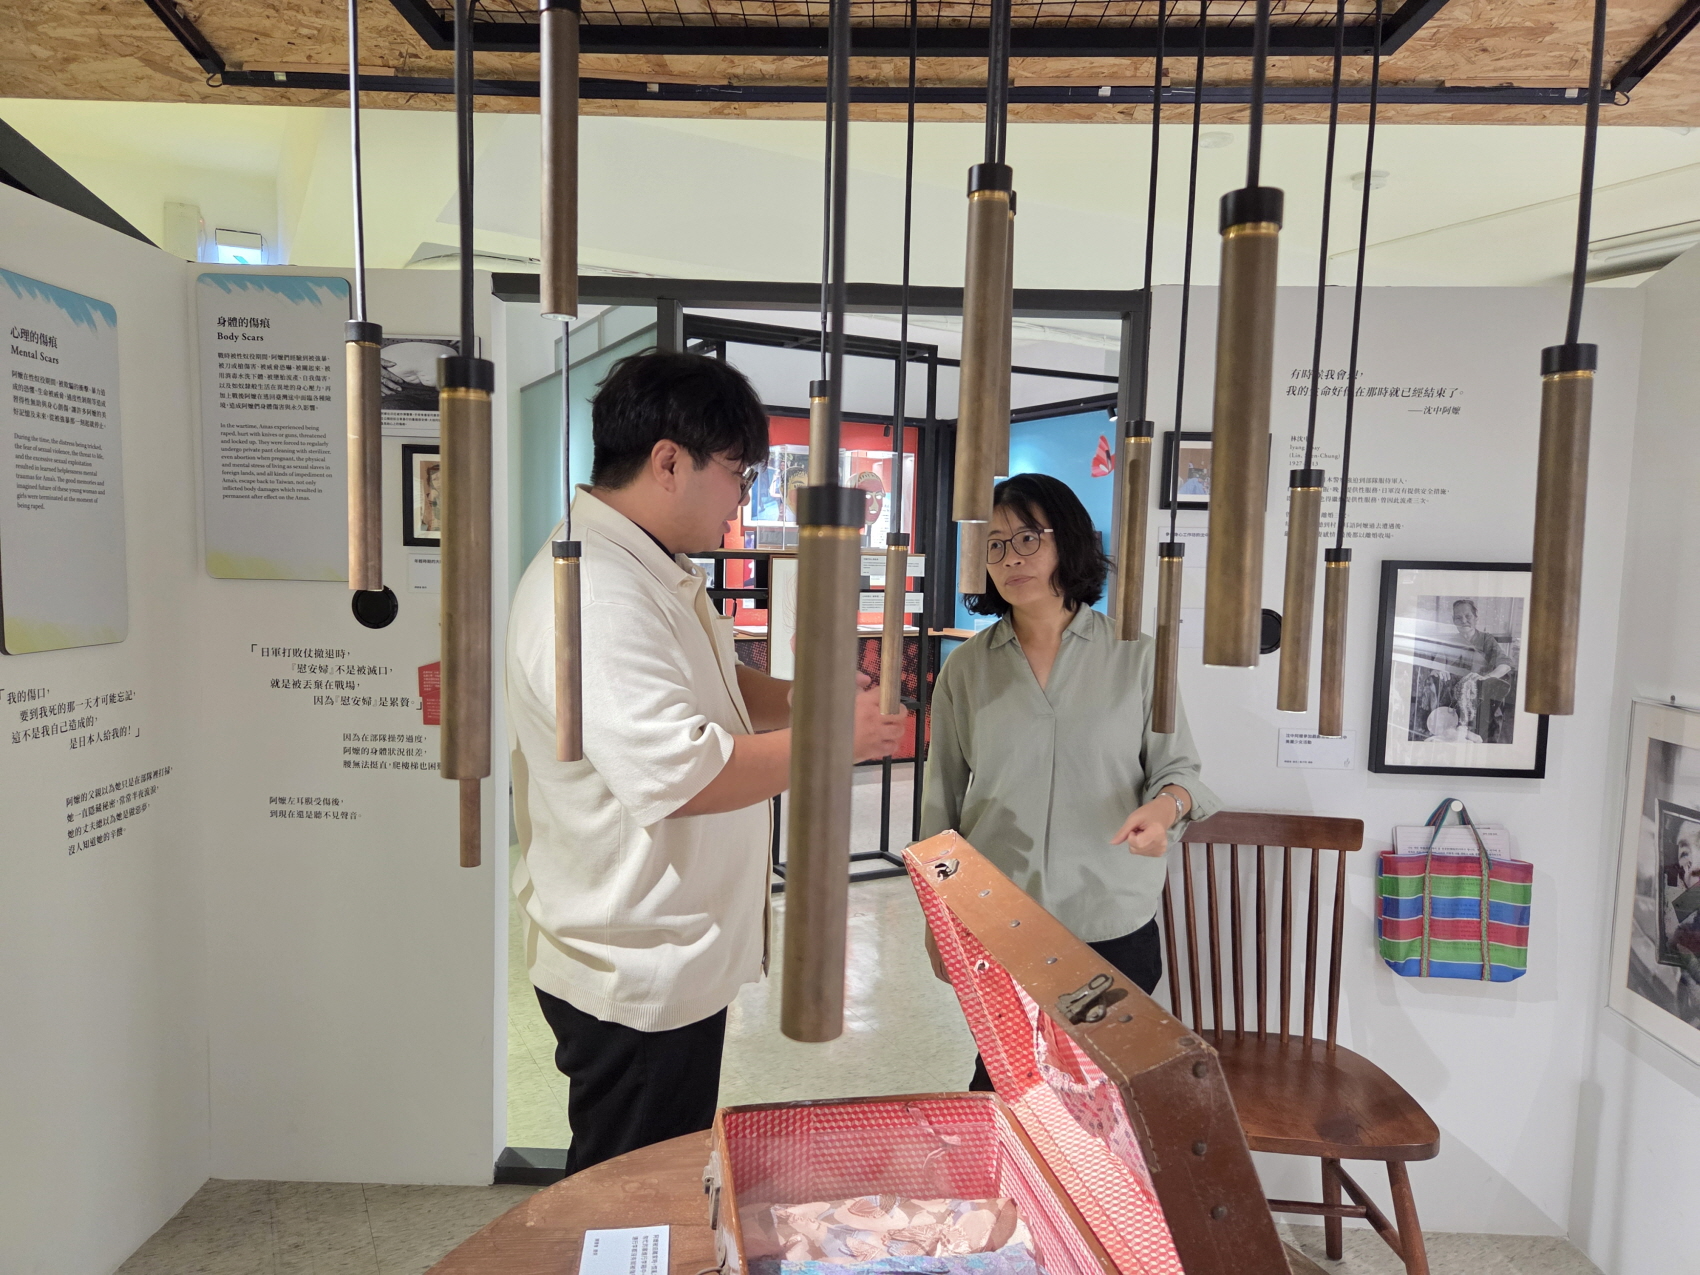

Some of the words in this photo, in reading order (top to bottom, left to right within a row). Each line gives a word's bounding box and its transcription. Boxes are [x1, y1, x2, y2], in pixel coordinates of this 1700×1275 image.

[217, 316, 270, 329] 身體的傷痕
[10, 326, 58, 349] 心理的傷痕
[217, 332, 239, 342] Body
[242, 333, 264, 341] Scars
[11, 345, 38, 360] Mental
[40, 352, 59, 364] Scars
[1286, 385, 1465, 399] 我的命好在那時就已經結束了。
[251, 644, 351, 659] 「日軍打敗仗撤退時，
[270, 678, 360, 691] 就是被丟棄在戰場，
[19, 689, 136, 723] 要到我死的那一天才可能忘記，
[11, 715, 98, 744] 這不是我自己造成的，
